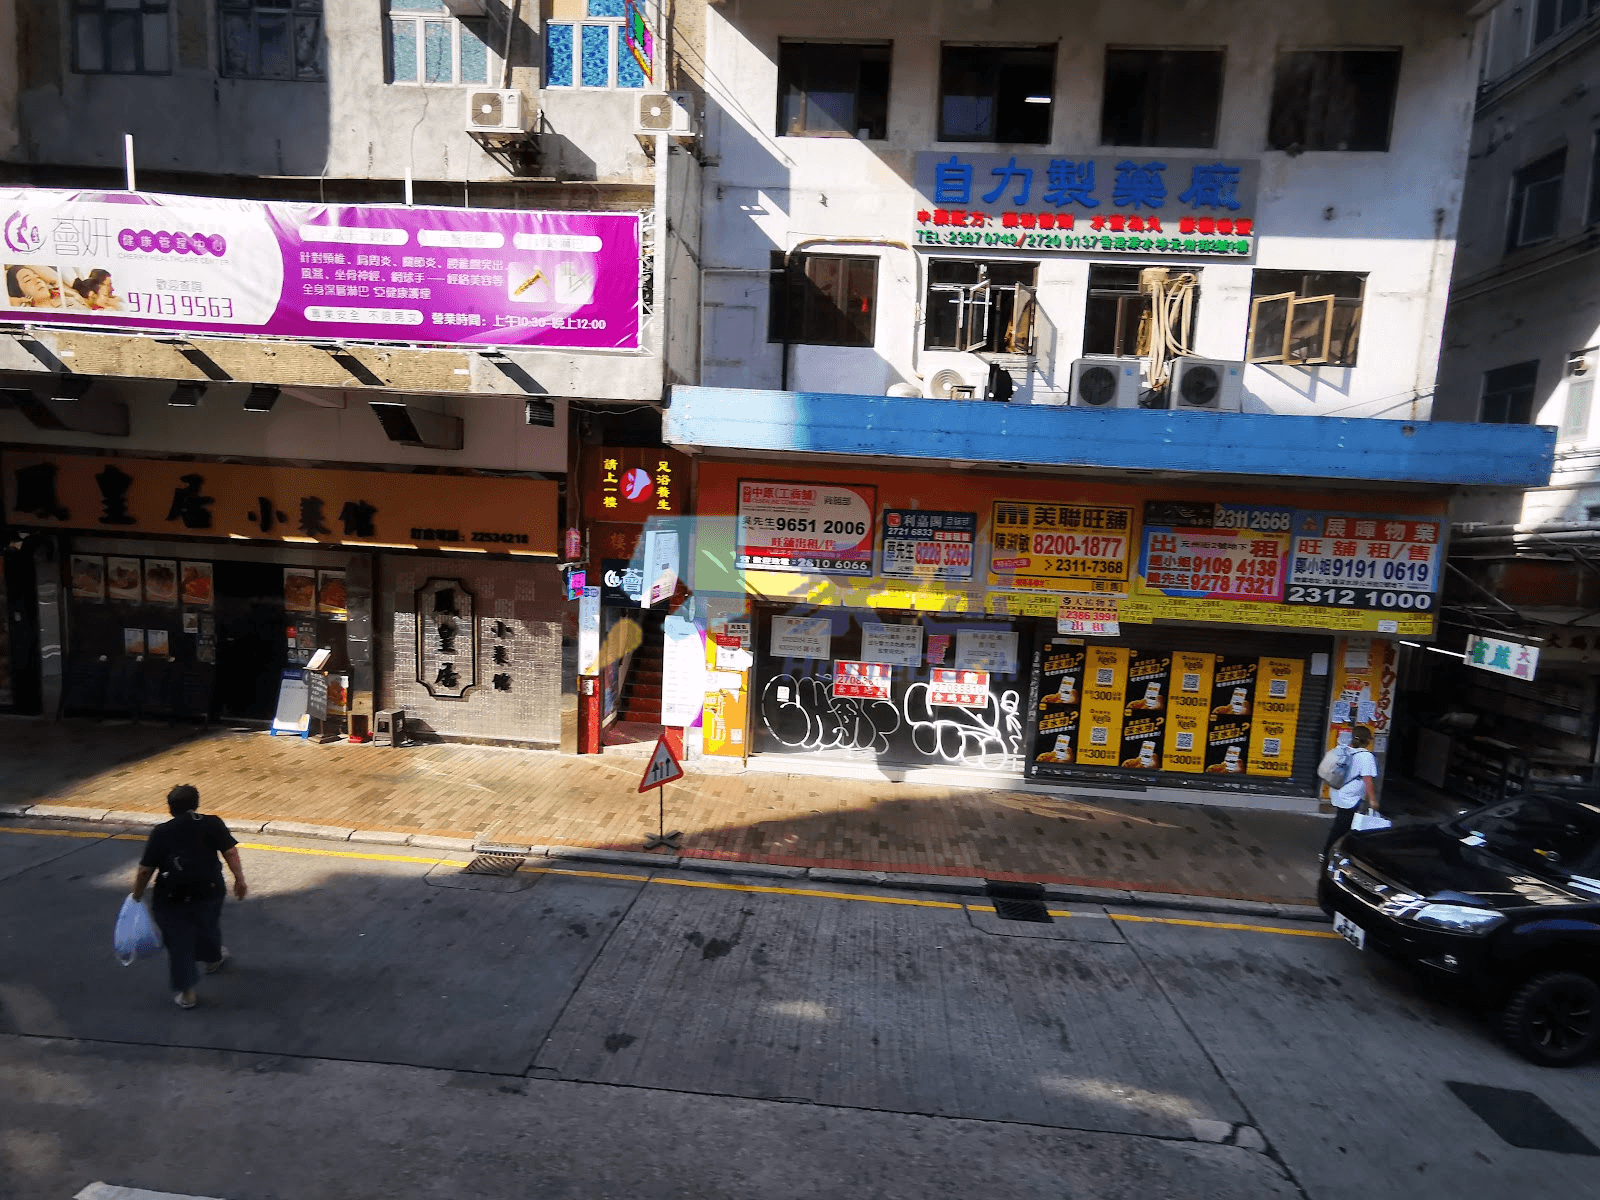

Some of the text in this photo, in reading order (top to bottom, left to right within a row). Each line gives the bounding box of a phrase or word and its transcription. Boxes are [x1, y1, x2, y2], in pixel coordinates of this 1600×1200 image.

[935, 156, 1242, 211] 自力製藥廠
[128, 292, 233, 318] 9713 9563
[603, 458, 618, 508] 請上一樓
[656, 460, 671, 510] 足浴養生
[776, 517, 816, 533] 9651
[823, 520, 866, 535] 2006
[1034, 506, 1128, 530] 美聯旺舖
[1215, 509, 1248, 529] 2311
[1250, 511, 1290, 531] 2668
[1033, 534, 1123, 557] 8200-1877
[1151, 535, 1177, 553] 出
[1250, 540, 1279, 558] 租
[1056, 558, 1123, 574] 2311-7368
[1192, 557, 1232, 574] 9109
[1236, 559, 1277, 576] 4138
[1332, 558, 1376, 578] 9191
[1383, 561, 1428, 581] 0619
[1191, 574, 1231, 592] 9278
[1235, 577, 1274, 595] 7321
[1288, 586, 1431, 610] 2312 1000
